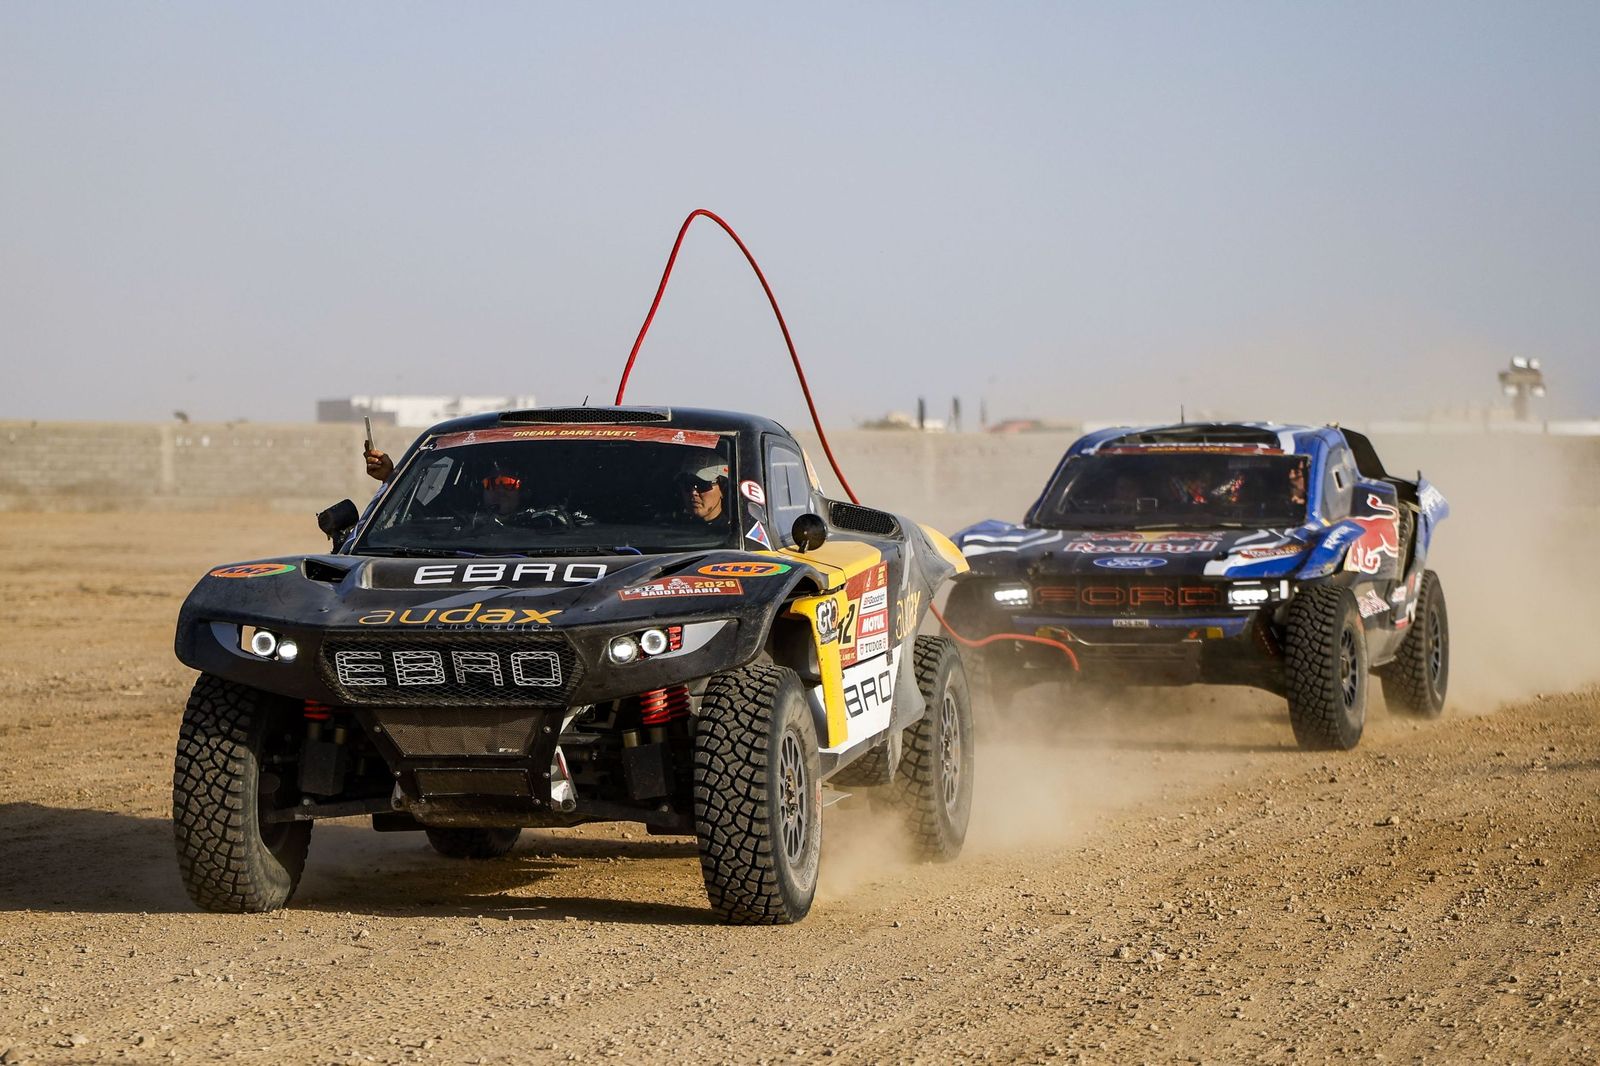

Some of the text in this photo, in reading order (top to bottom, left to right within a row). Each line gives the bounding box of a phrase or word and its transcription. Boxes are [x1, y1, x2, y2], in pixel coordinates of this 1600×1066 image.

[512, 429, 557, 438] DREAM.
[558, 429, 593, 437] DARE.
[596, 429, 621, 437] LIVE
[1063, 541, 1219, 554] Red Bull
[1106, 557, 1153, 568] Ford
[413, 563, 608, 585] EBRO
[640, 588, 676, 597] SAUDI
[678, 587, 721, 595] ARABIA
[694, 580, 736, 589] 2026
[1034, 587, 1223, 606] FORD
[358, 603, 564, 625] audax
[424, 622, 553, 632] renovables
[837, 604, 855, 644] 12
[861, 613, 885, 633] MOTUL
[865, 639, 882, 653] TUDOR
[334, 650, 563, 687] EBRO
[843, 670, 892, 718] BRO
